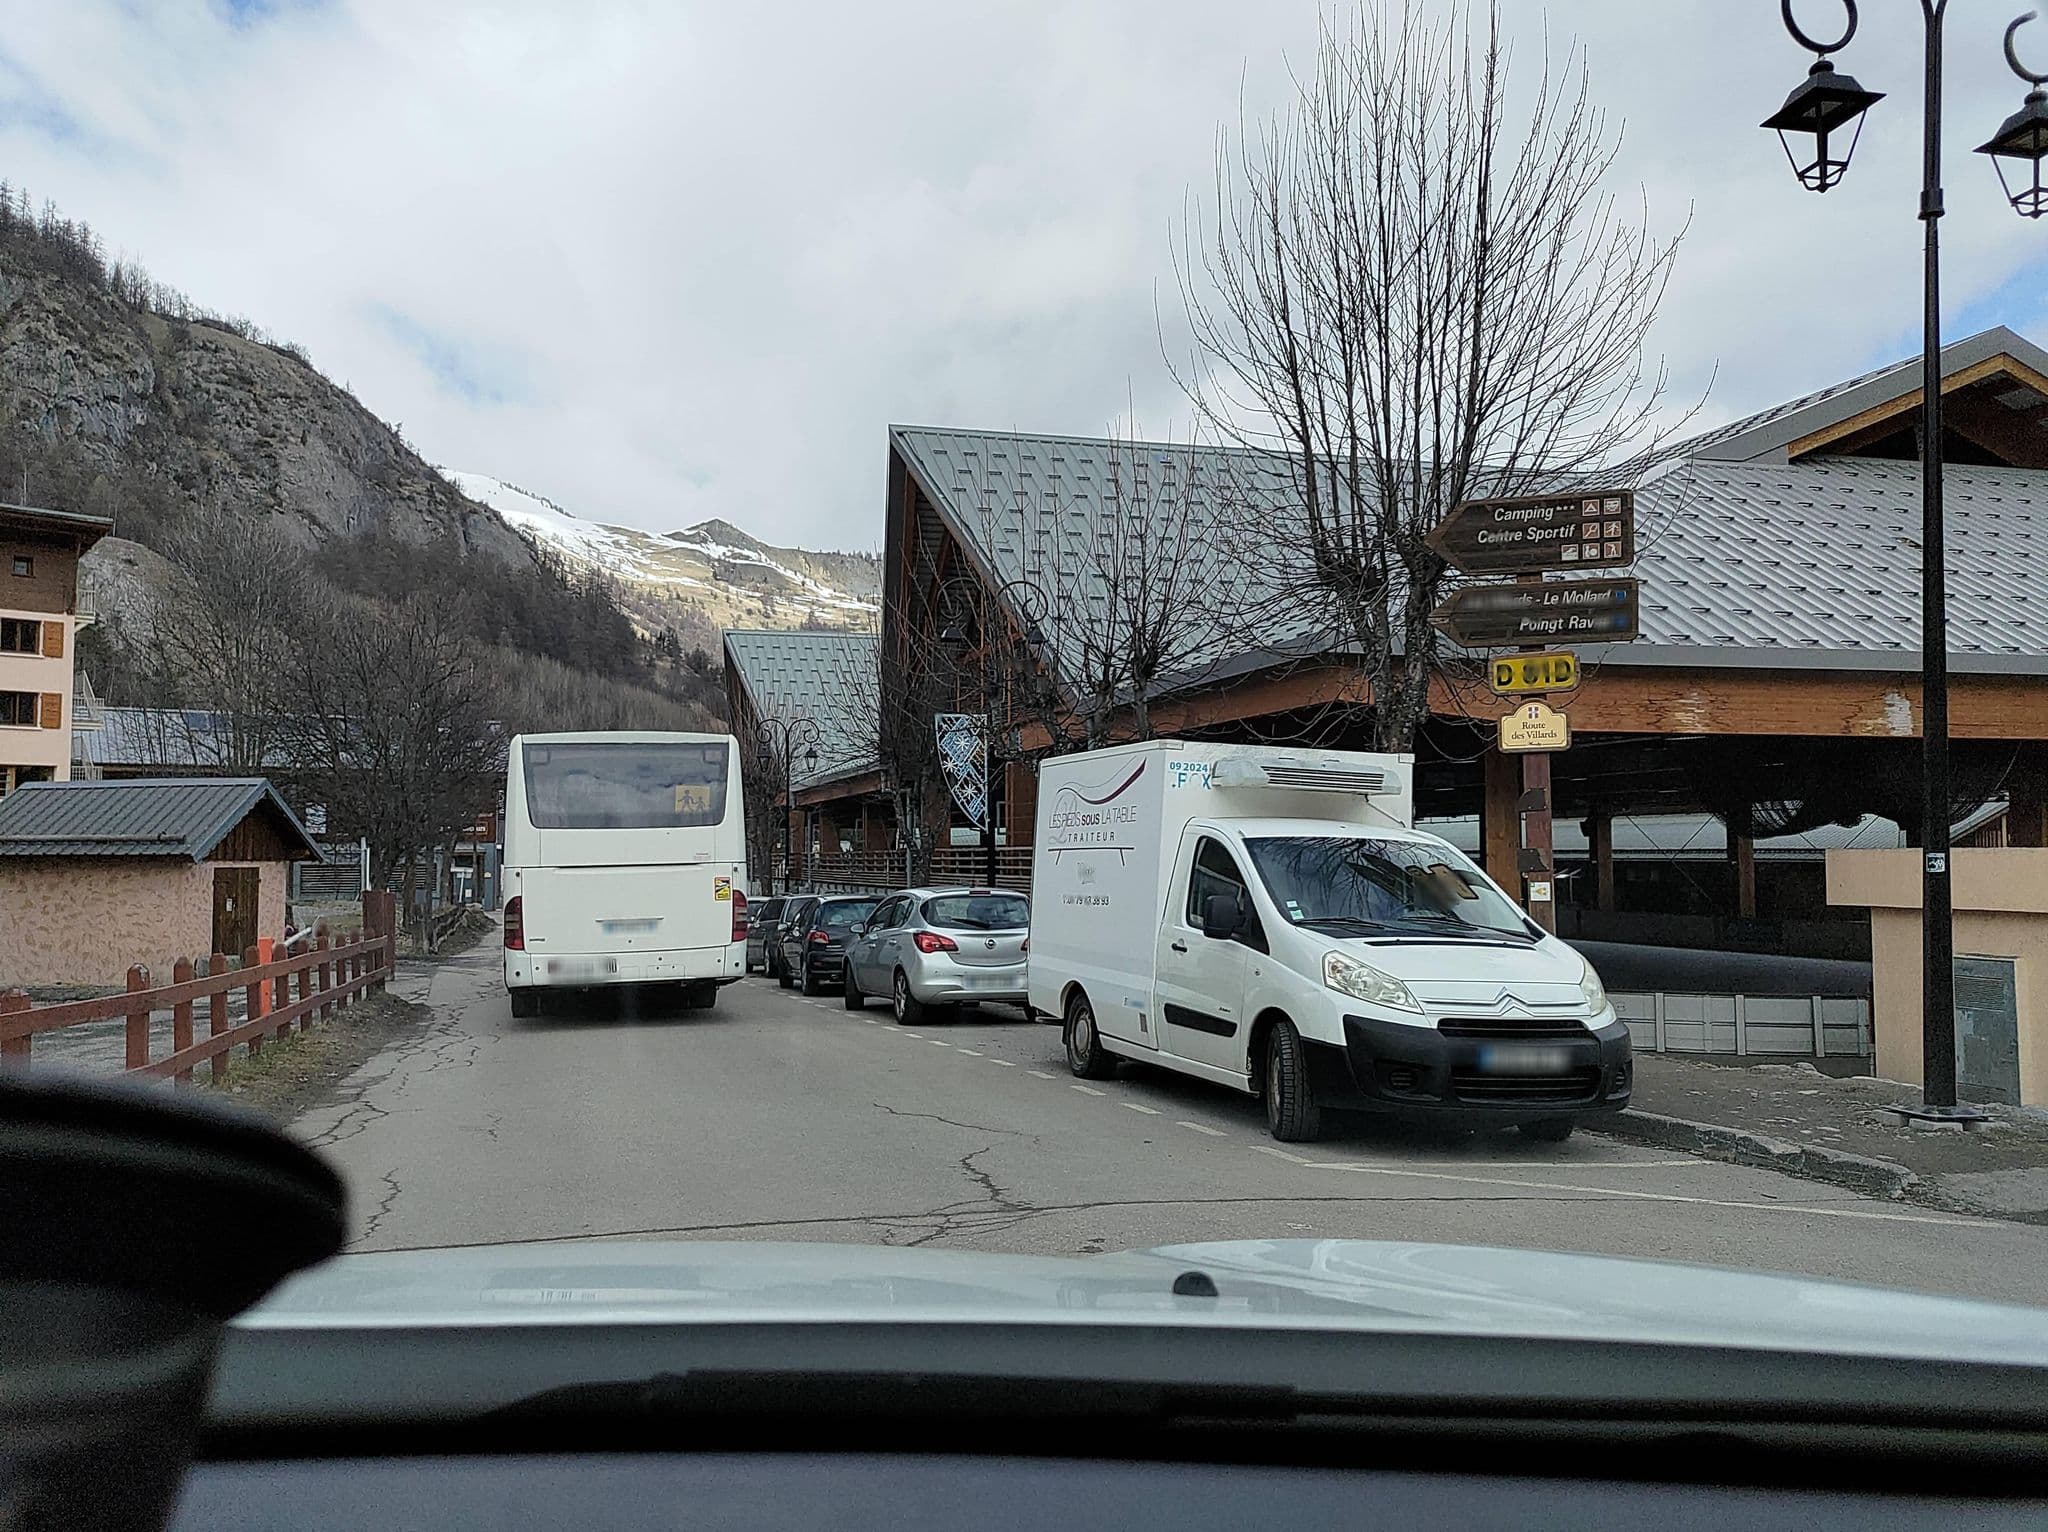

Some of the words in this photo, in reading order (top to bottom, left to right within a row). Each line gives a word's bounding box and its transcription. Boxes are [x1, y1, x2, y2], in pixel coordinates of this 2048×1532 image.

[1494, 505, 1554, 523] Camping
[1477, 529, 1523, 544] Centre
[1526, 524, 1576, 543] Sportif
[1543, 591, 1559, 606] Le
[1562, 589, 1612, 605] Mollard
[1519, 616, 1564, 633] Poingt
[1521, 721, 1546, 730] Route
[1511, 731, 1525, 740] des
[1526, 730, 1558, 739] Villards
[1112, 805, 1137, 823] TABLE
[1068, 831, 1115, 843] TRAITEUR
